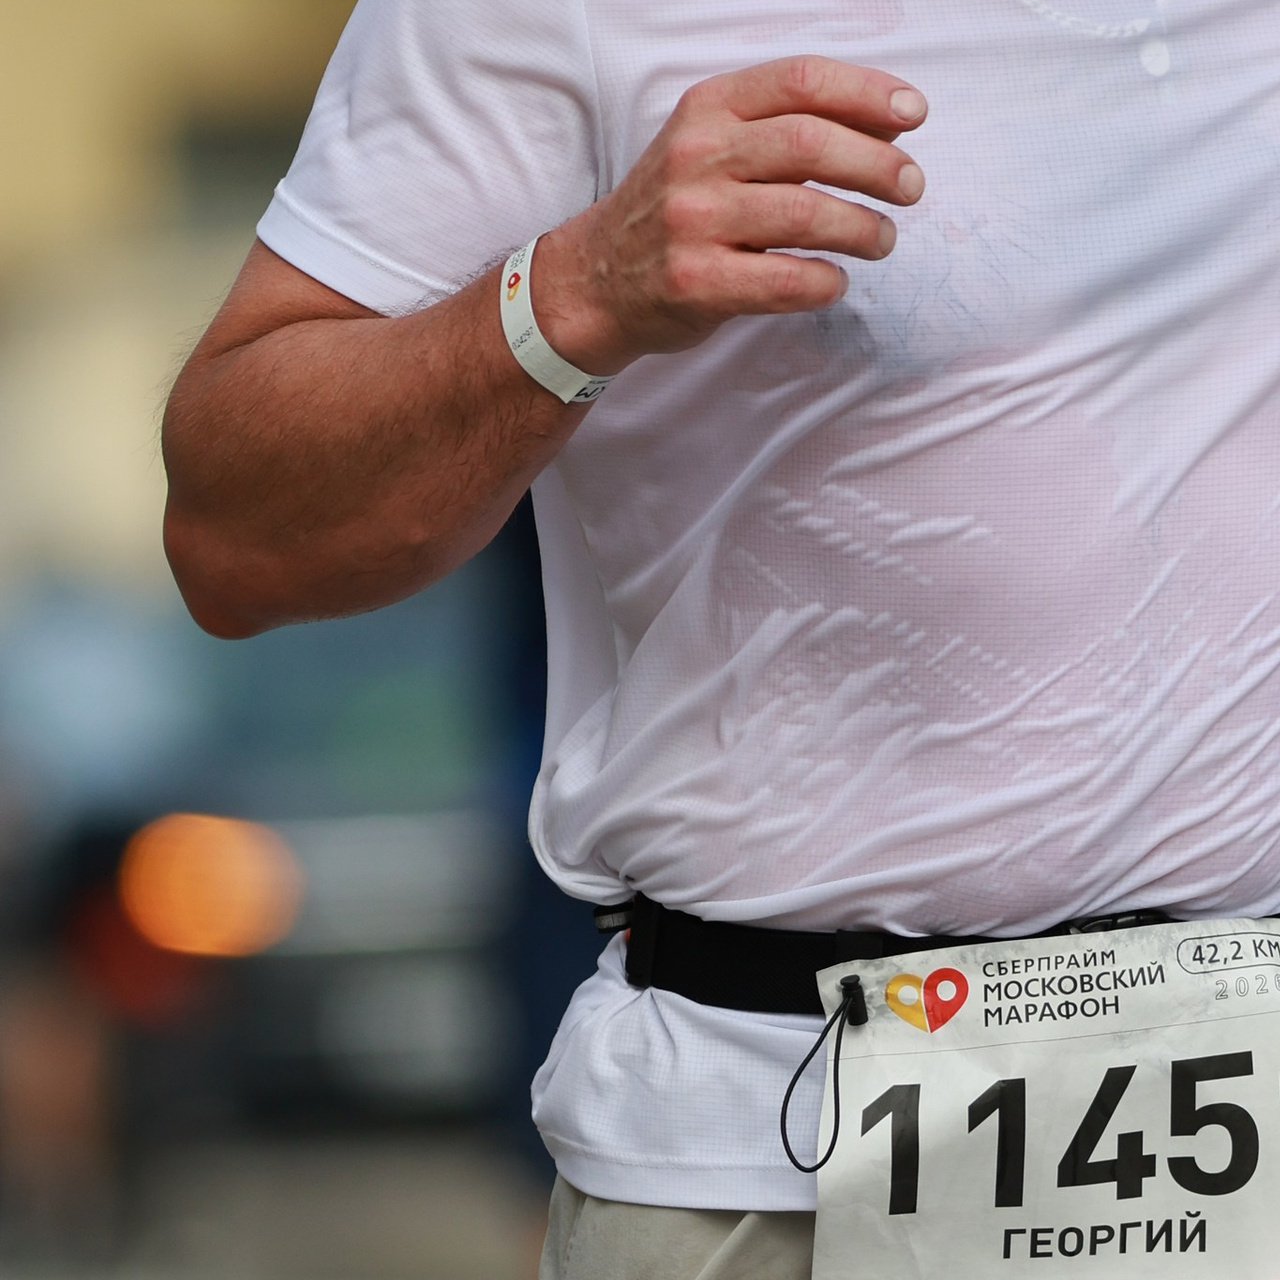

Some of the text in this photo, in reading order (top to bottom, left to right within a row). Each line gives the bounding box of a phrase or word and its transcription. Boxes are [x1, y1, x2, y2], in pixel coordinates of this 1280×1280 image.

[982, 949, 1116, 977] СБЕРПРАЙМ
[1192, 940, 1243, 965] 42,2
[983, 961, 1166, 1002] МОСКОВСКИЙ
[983, 995, 1120, 1027] МАРАФОН
[1002, 1211, 1207, 1260] ГЕОРГИЙ
